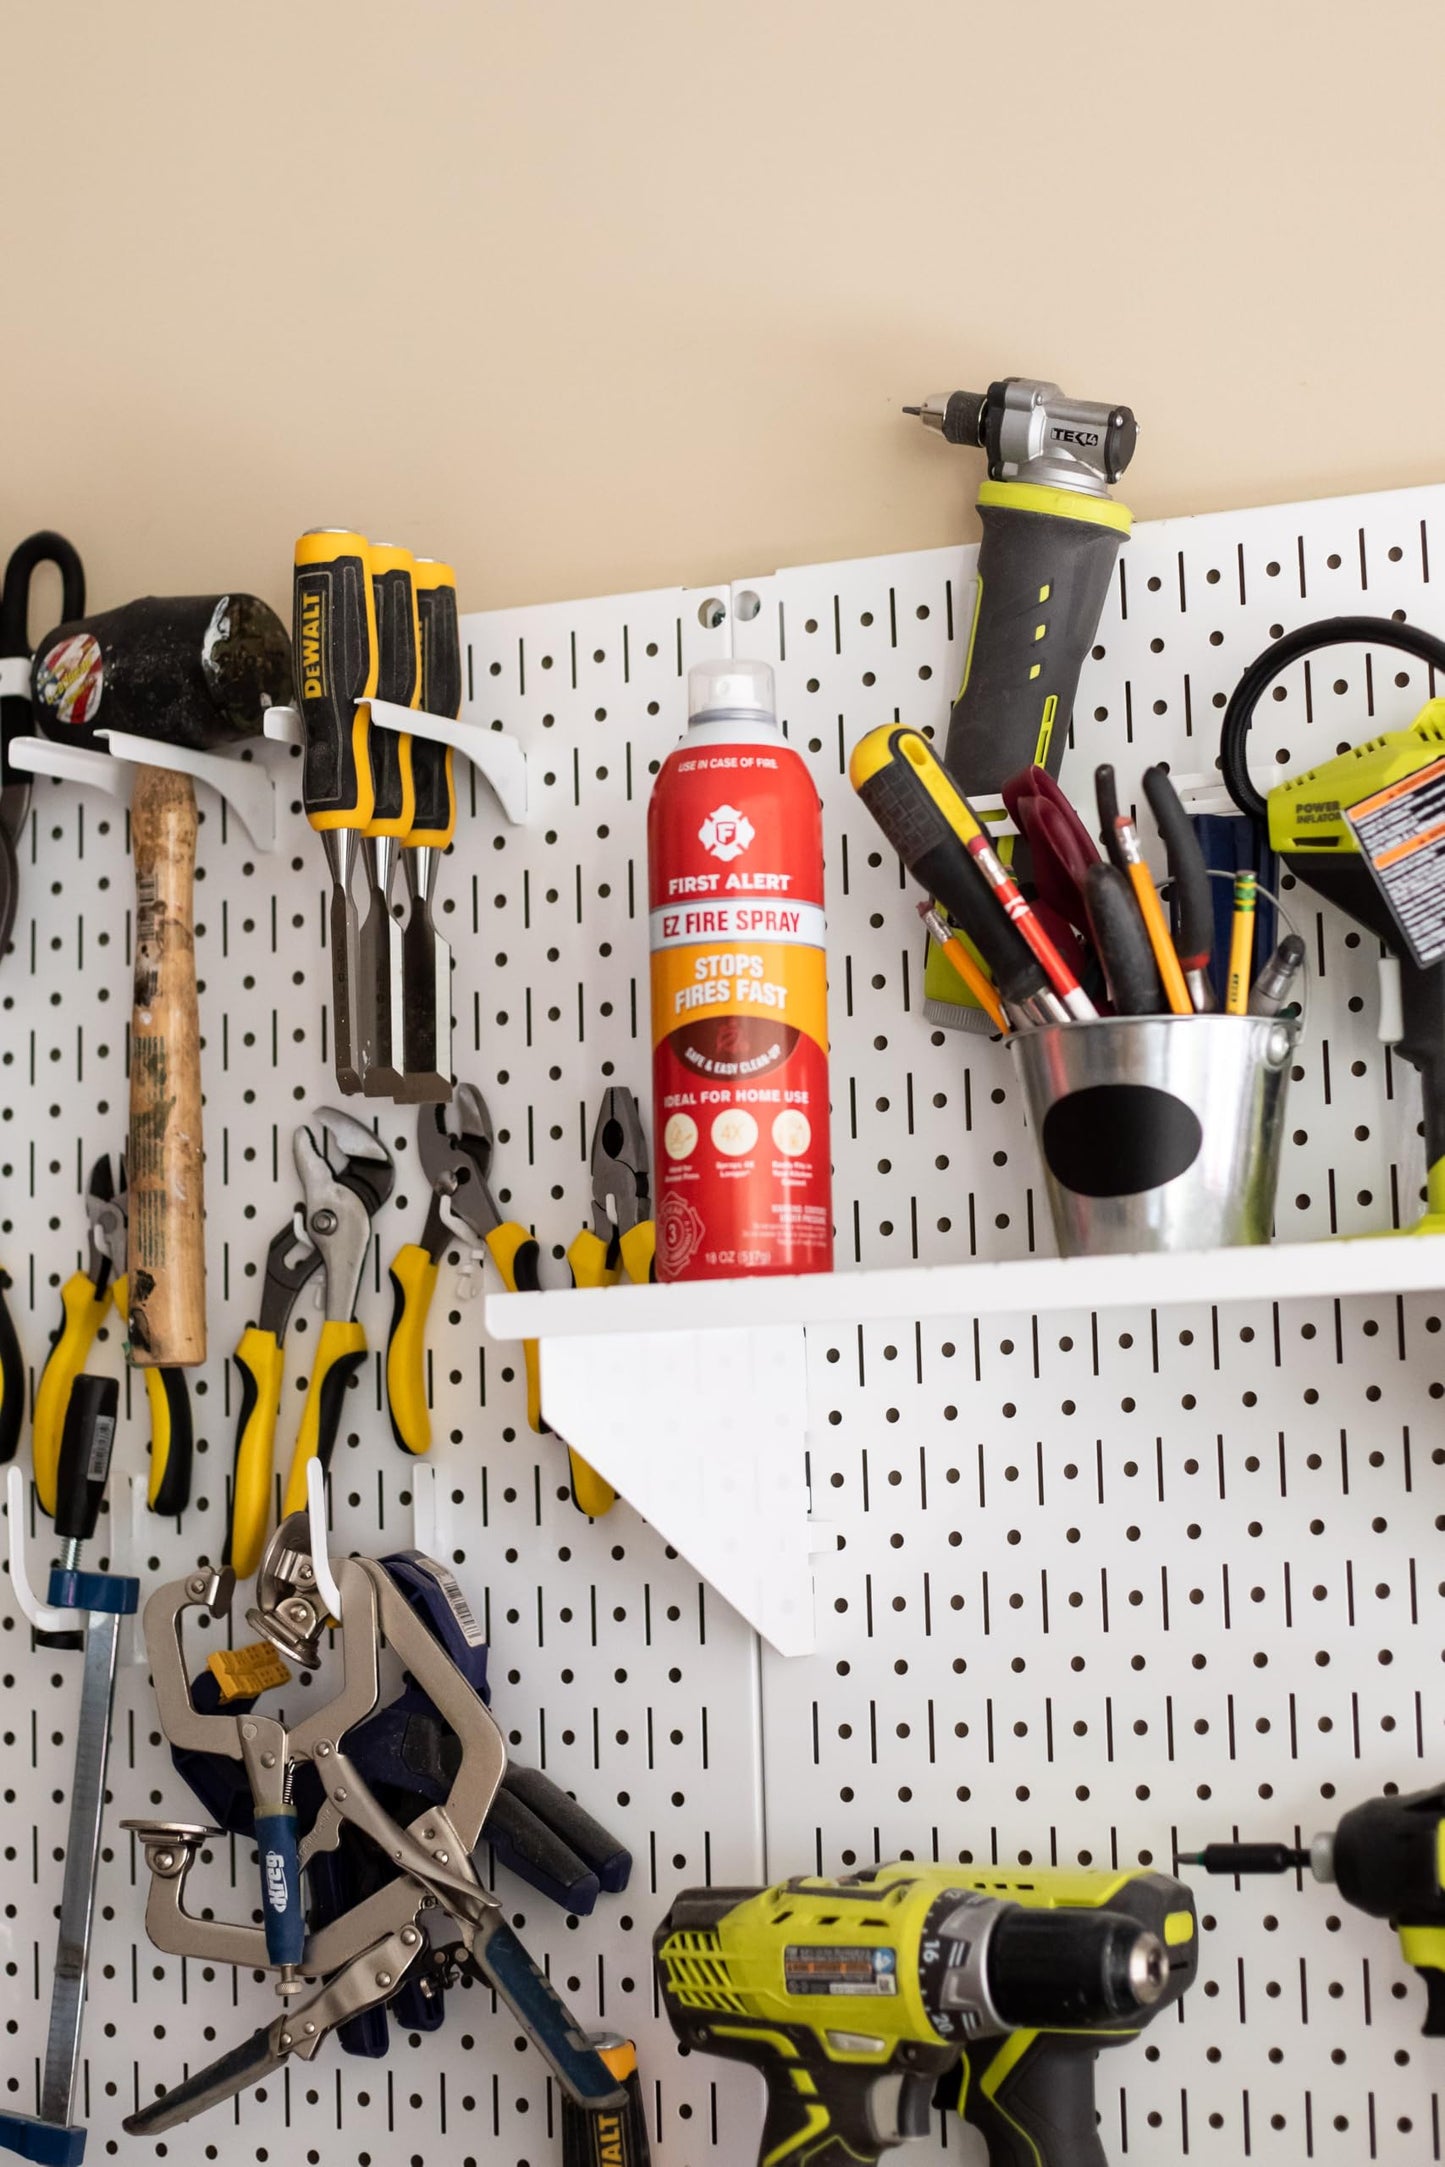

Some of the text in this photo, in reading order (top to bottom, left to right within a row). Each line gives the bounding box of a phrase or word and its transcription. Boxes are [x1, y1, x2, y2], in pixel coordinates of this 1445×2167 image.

[678, 762, 696, 773] USE
[697, 759, 708, 770] IN
[709, 757, 738, 769] CASE
[739, 756, 754, 768] OF
[1296, 800, 1340, 814] POWER
[1296, 811, 1343, 824] INFLATOR
[668, 872, 792, 896] FIRST ALERT
[663, 910, 800, 939] EZ FIRE SPRAY
[695, 953, 764, 980] STOPS
[674, 979, 789, 1015] FIRES FAST
[713, 1061, 738, 1075] EASY
[664, 1088, 809, 1108] IDEAL FOR HOME USE
[668, 1223, 677, 1245] 3
[718, 1250, 736, 1265] OZ
[266, 1853, 287, 1906] Kreg
[923, 1940, 940, 1964] 16
[932, 2012, 954, 2034] 20
[598, 2113, 623, 2167] ALT
